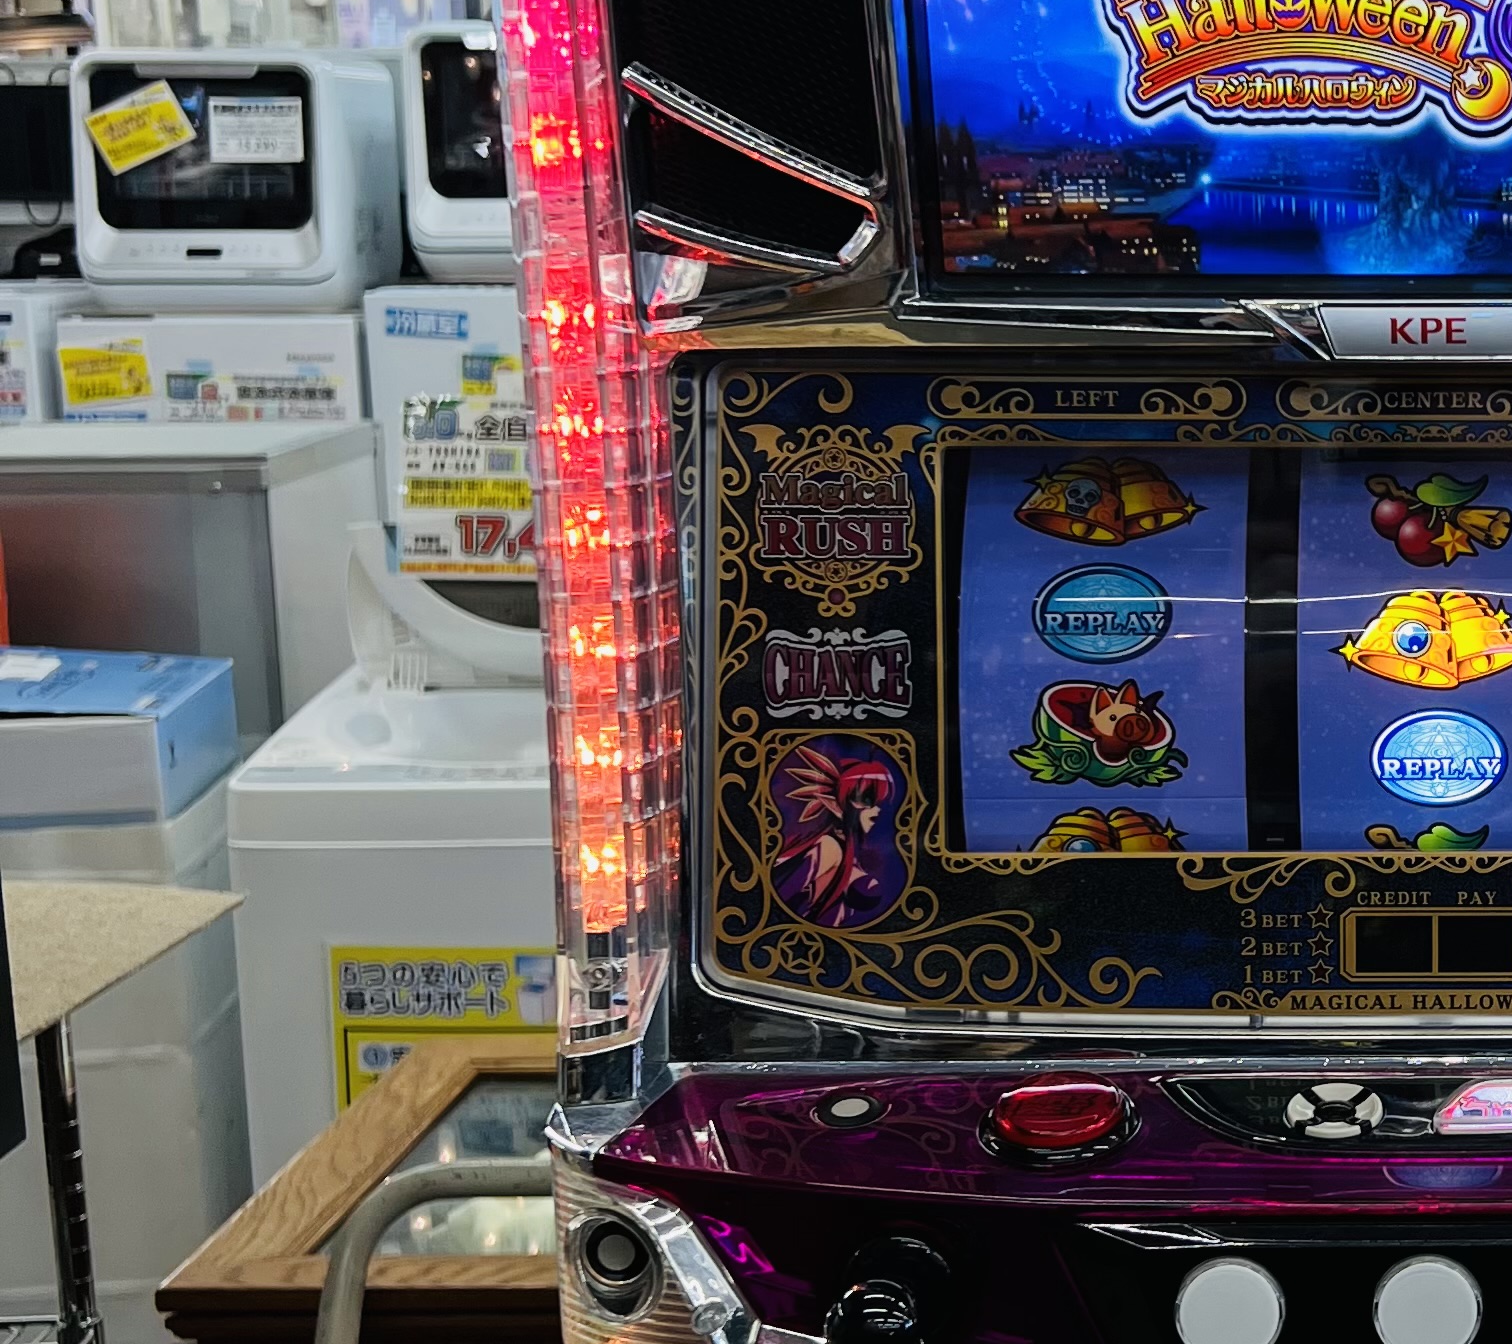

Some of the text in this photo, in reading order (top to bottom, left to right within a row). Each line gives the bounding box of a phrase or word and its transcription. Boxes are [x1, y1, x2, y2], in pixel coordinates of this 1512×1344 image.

[1198, 74, 1417, 109] マジカルハロウィン
[1389, 317, 1468, 345] KPE
[1055, 390, 1119, 408] LEFT
[1384, 391, 1485, 409] CENTER
[761, 472, 909, 511] Magical
[762, 514, 910, 558] RUSH
[1043, 612, 1166, 637] REPLAY
[764, 640, 910, 708] CHANCE
[1380, 758, 1502, 780] REPLAY
[1357, 891, 1431, 906] CREDIT
[1457, 891, 1498, 906] PAY
[1240, 909, 1303, 928] 3 BET
[1240, 937, 1303, 956] 2 BET
[1243, 965, 1303, 984] 1 BET
[1290, 995, 1402, 1011] MAGICAL
